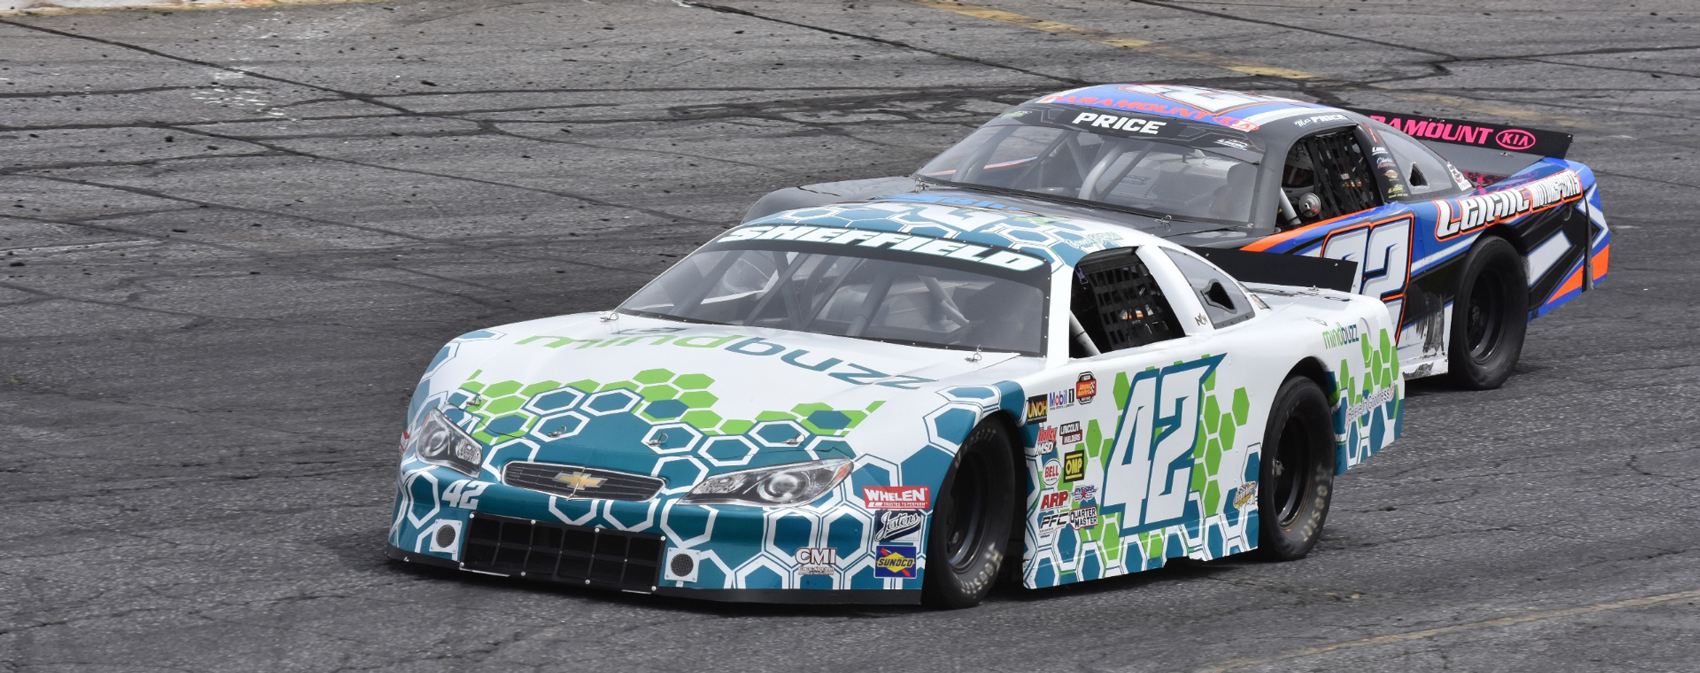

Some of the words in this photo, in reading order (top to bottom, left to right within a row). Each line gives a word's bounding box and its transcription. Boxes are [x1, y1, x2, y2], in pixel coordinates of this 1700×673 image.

[1072, 112, 1167, 135] PRICE
[1502, 133, 1529, 147] KIA
[716, 225, 1046, 272] SHEFFIELD
[1323, 323, 1360, 349] mindbuzz
[514, 334, 938, 391] mindbuzz
[1050, 389, 1068, 407] Mobil
[1027, 400, 1047, 418] UNOH
[1061, 423, 1079, 435] LINCOLN
[1101, 355, 1222, 535] 42
[1045, 465, 1059, 478] BELL
[1065, 458, 1083, 475] OMP
[442, 479, 496, 510] 42
[864, 487, 926, 502] WHELEN
[1041, 490, 1069, 509] ARP
[1041, 513, 1069, 529] PFC
[1070, 508, 1096, 523] QUARTER
[1075, 516, 1098, 528] MASTER
[795, 547, 837, 565] CMI
[877, 557, 914, 568] SUNOCO
